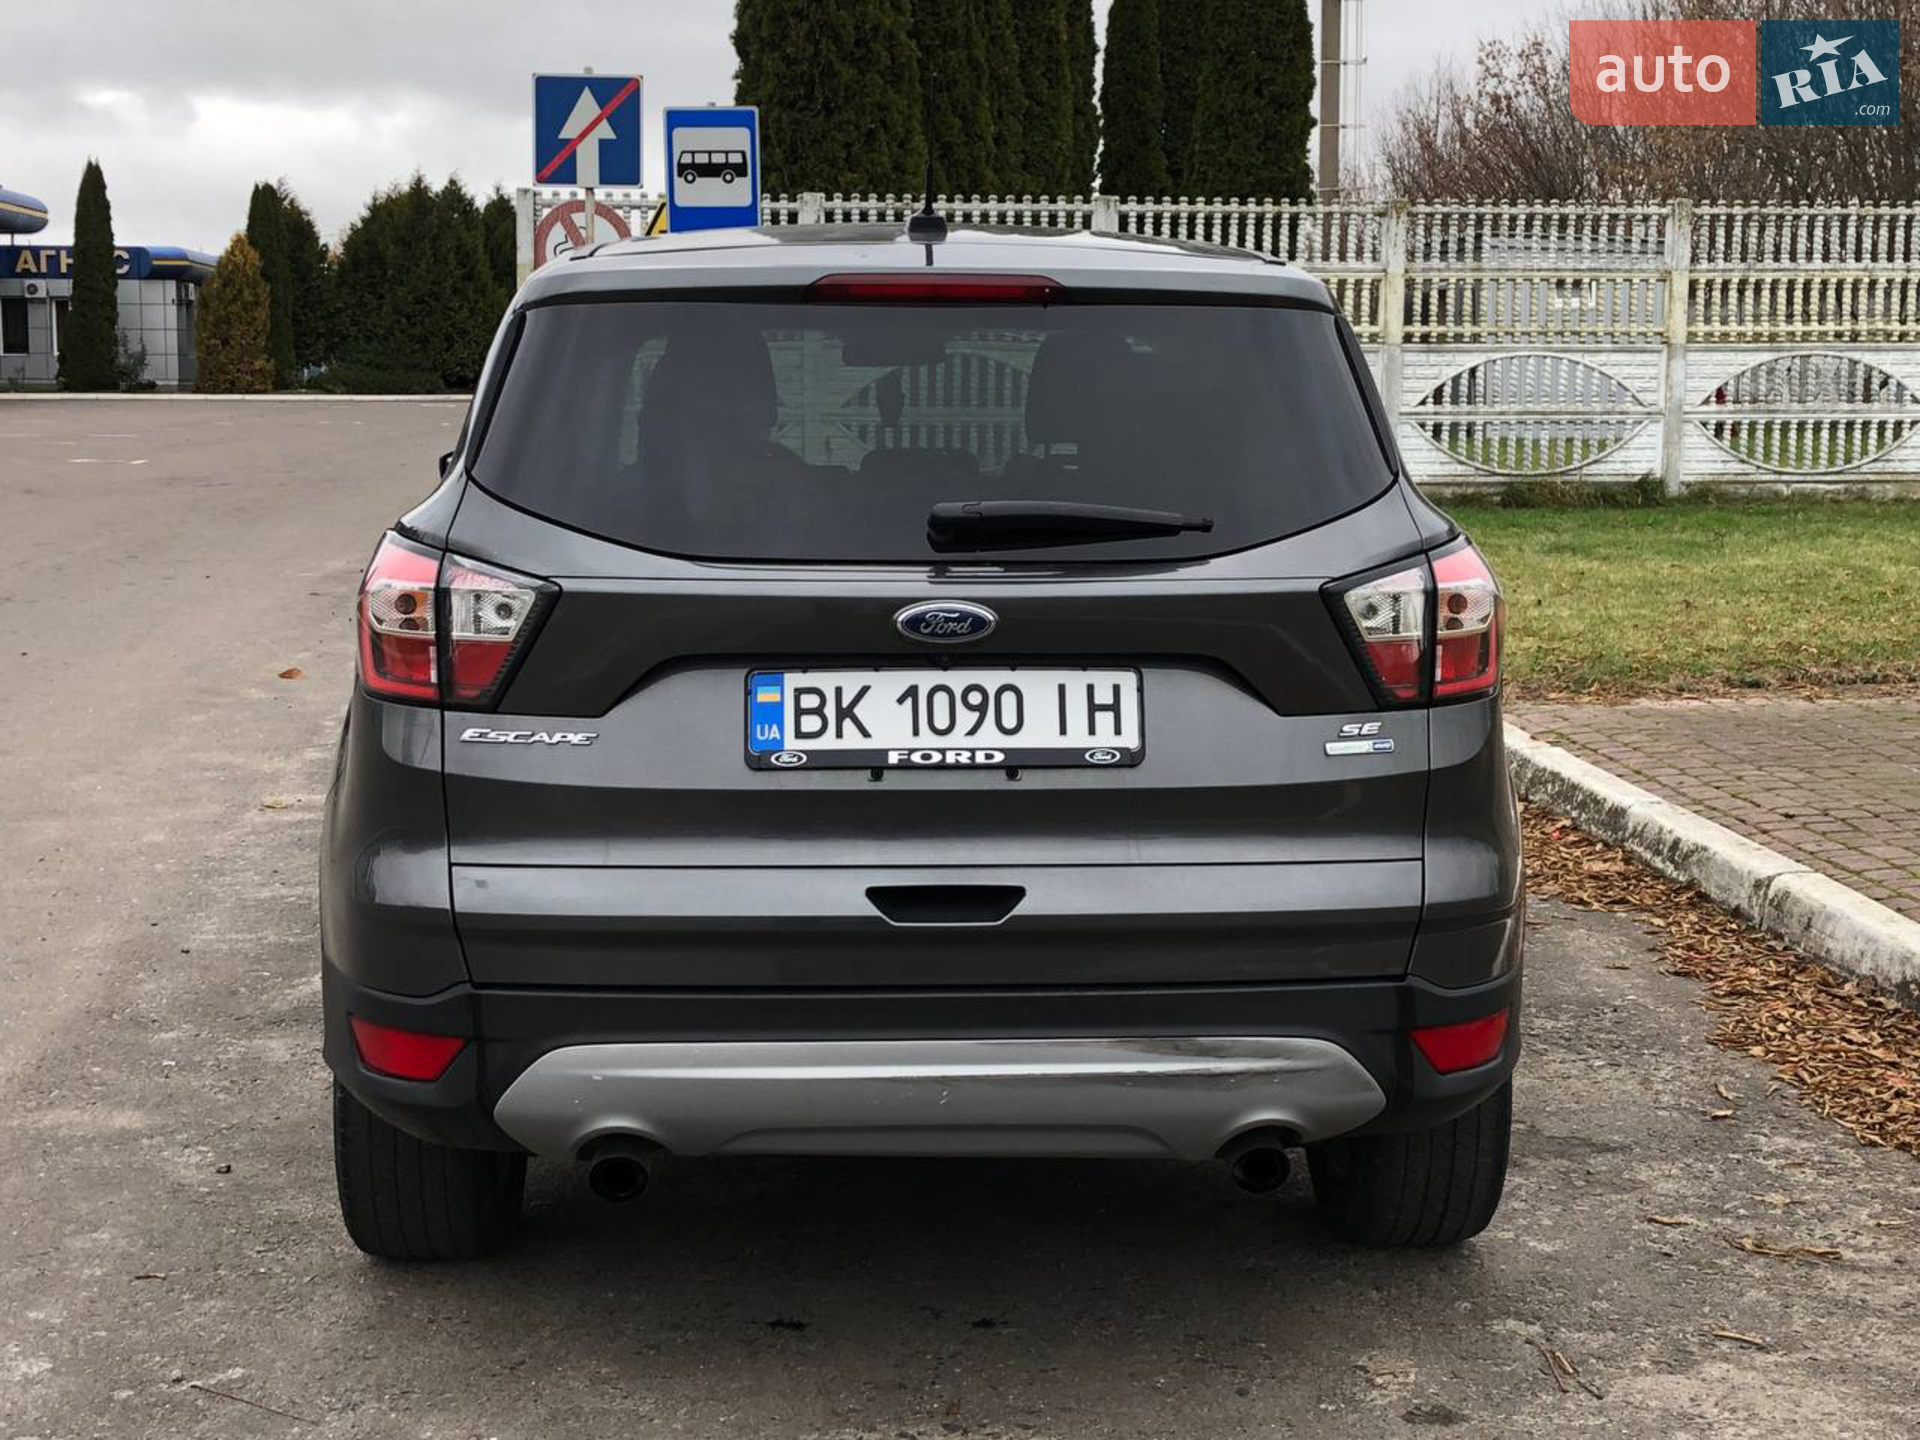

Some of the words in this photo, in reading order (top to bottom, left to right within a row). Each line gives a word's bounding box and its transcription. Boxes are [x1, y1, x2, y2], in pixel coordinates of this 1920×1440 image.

[15, 249, 131, 275] АГНС
[920, 611, 973, 634] Ford
[793, 685, 872, 740] BK
[896, 683, 1024, 737] 1090
[460, 728, 599, 745] ESCAPE
[756, 724, 781, 741] UA
[1339, 722, 1382, 736] SE
[887, 750, 1006, 764] FORD
